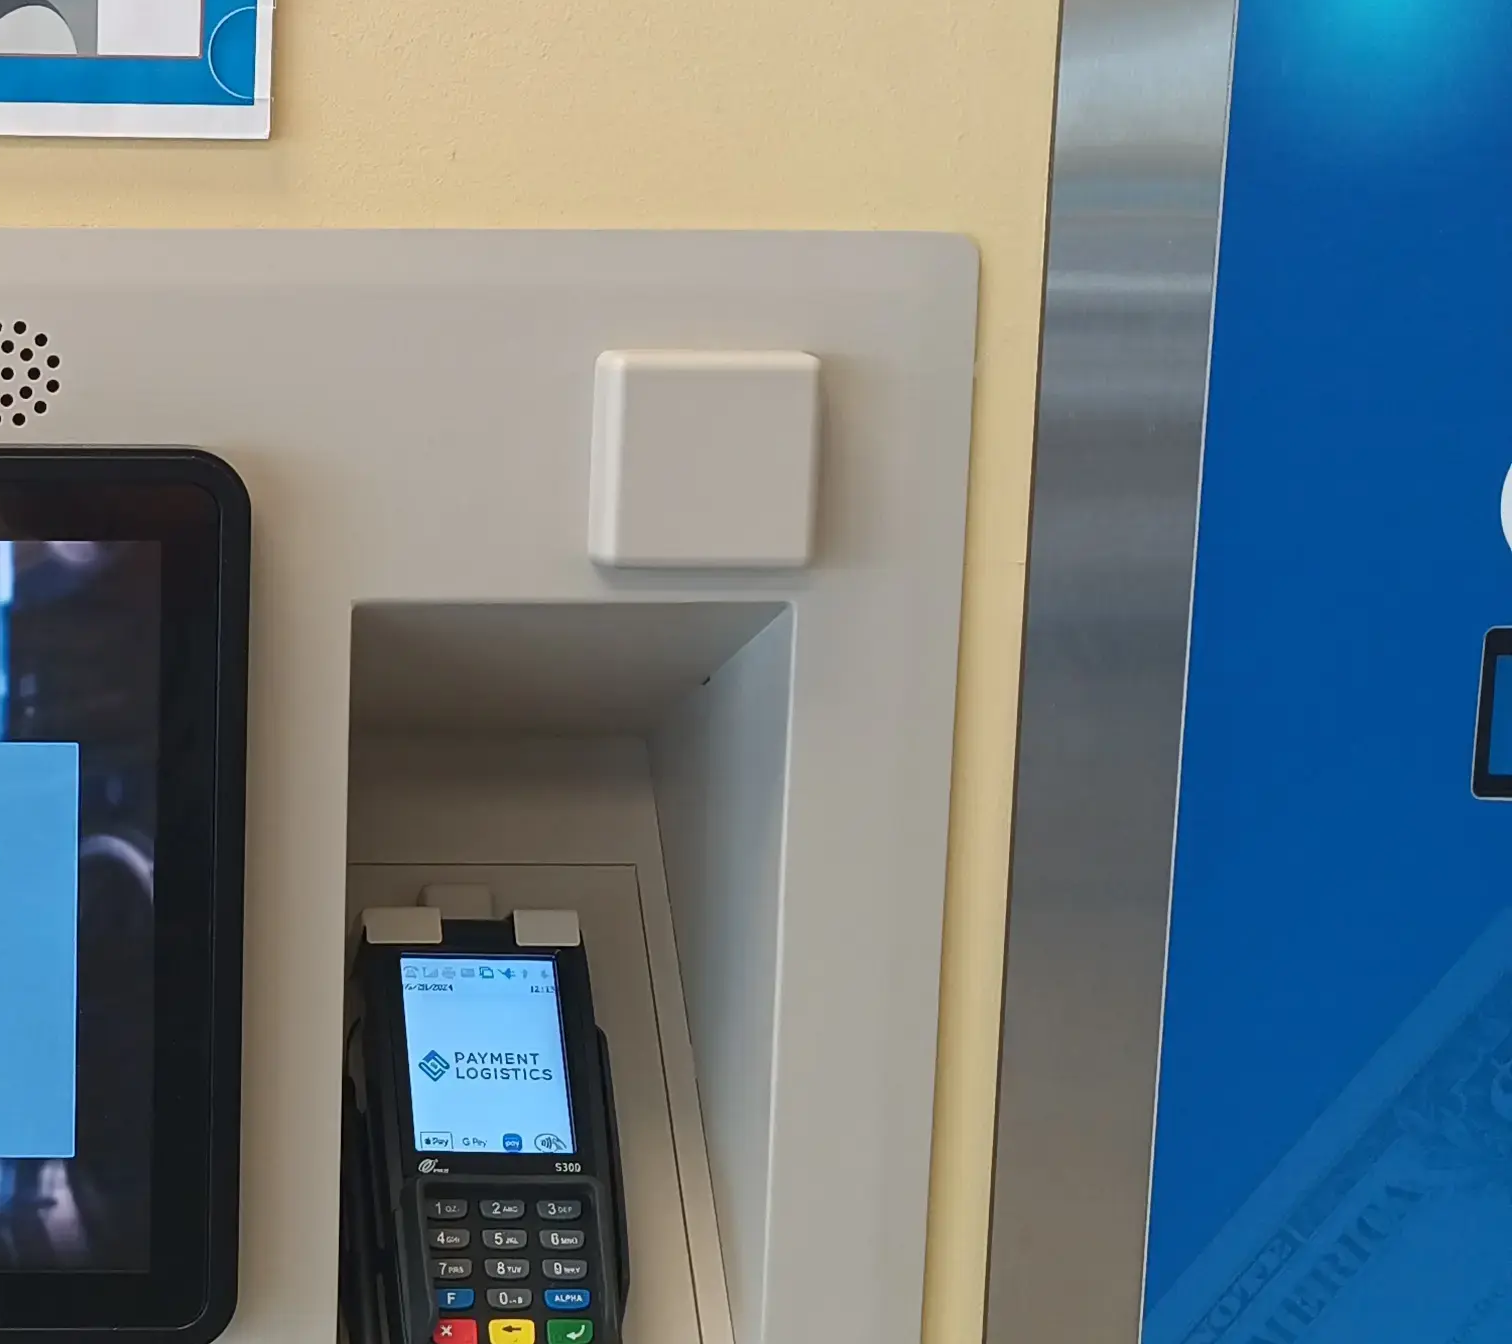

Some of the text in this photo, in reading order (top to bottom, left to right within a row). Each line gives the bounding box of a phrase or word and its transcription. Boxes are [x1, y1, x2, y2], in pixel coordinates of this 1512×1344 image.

[454, 1051, 540, 1066] PAYMENT
[455, 1068, 553, 1081] LOGISTICS
[554, 1294, 583, 1302] ALPHA
